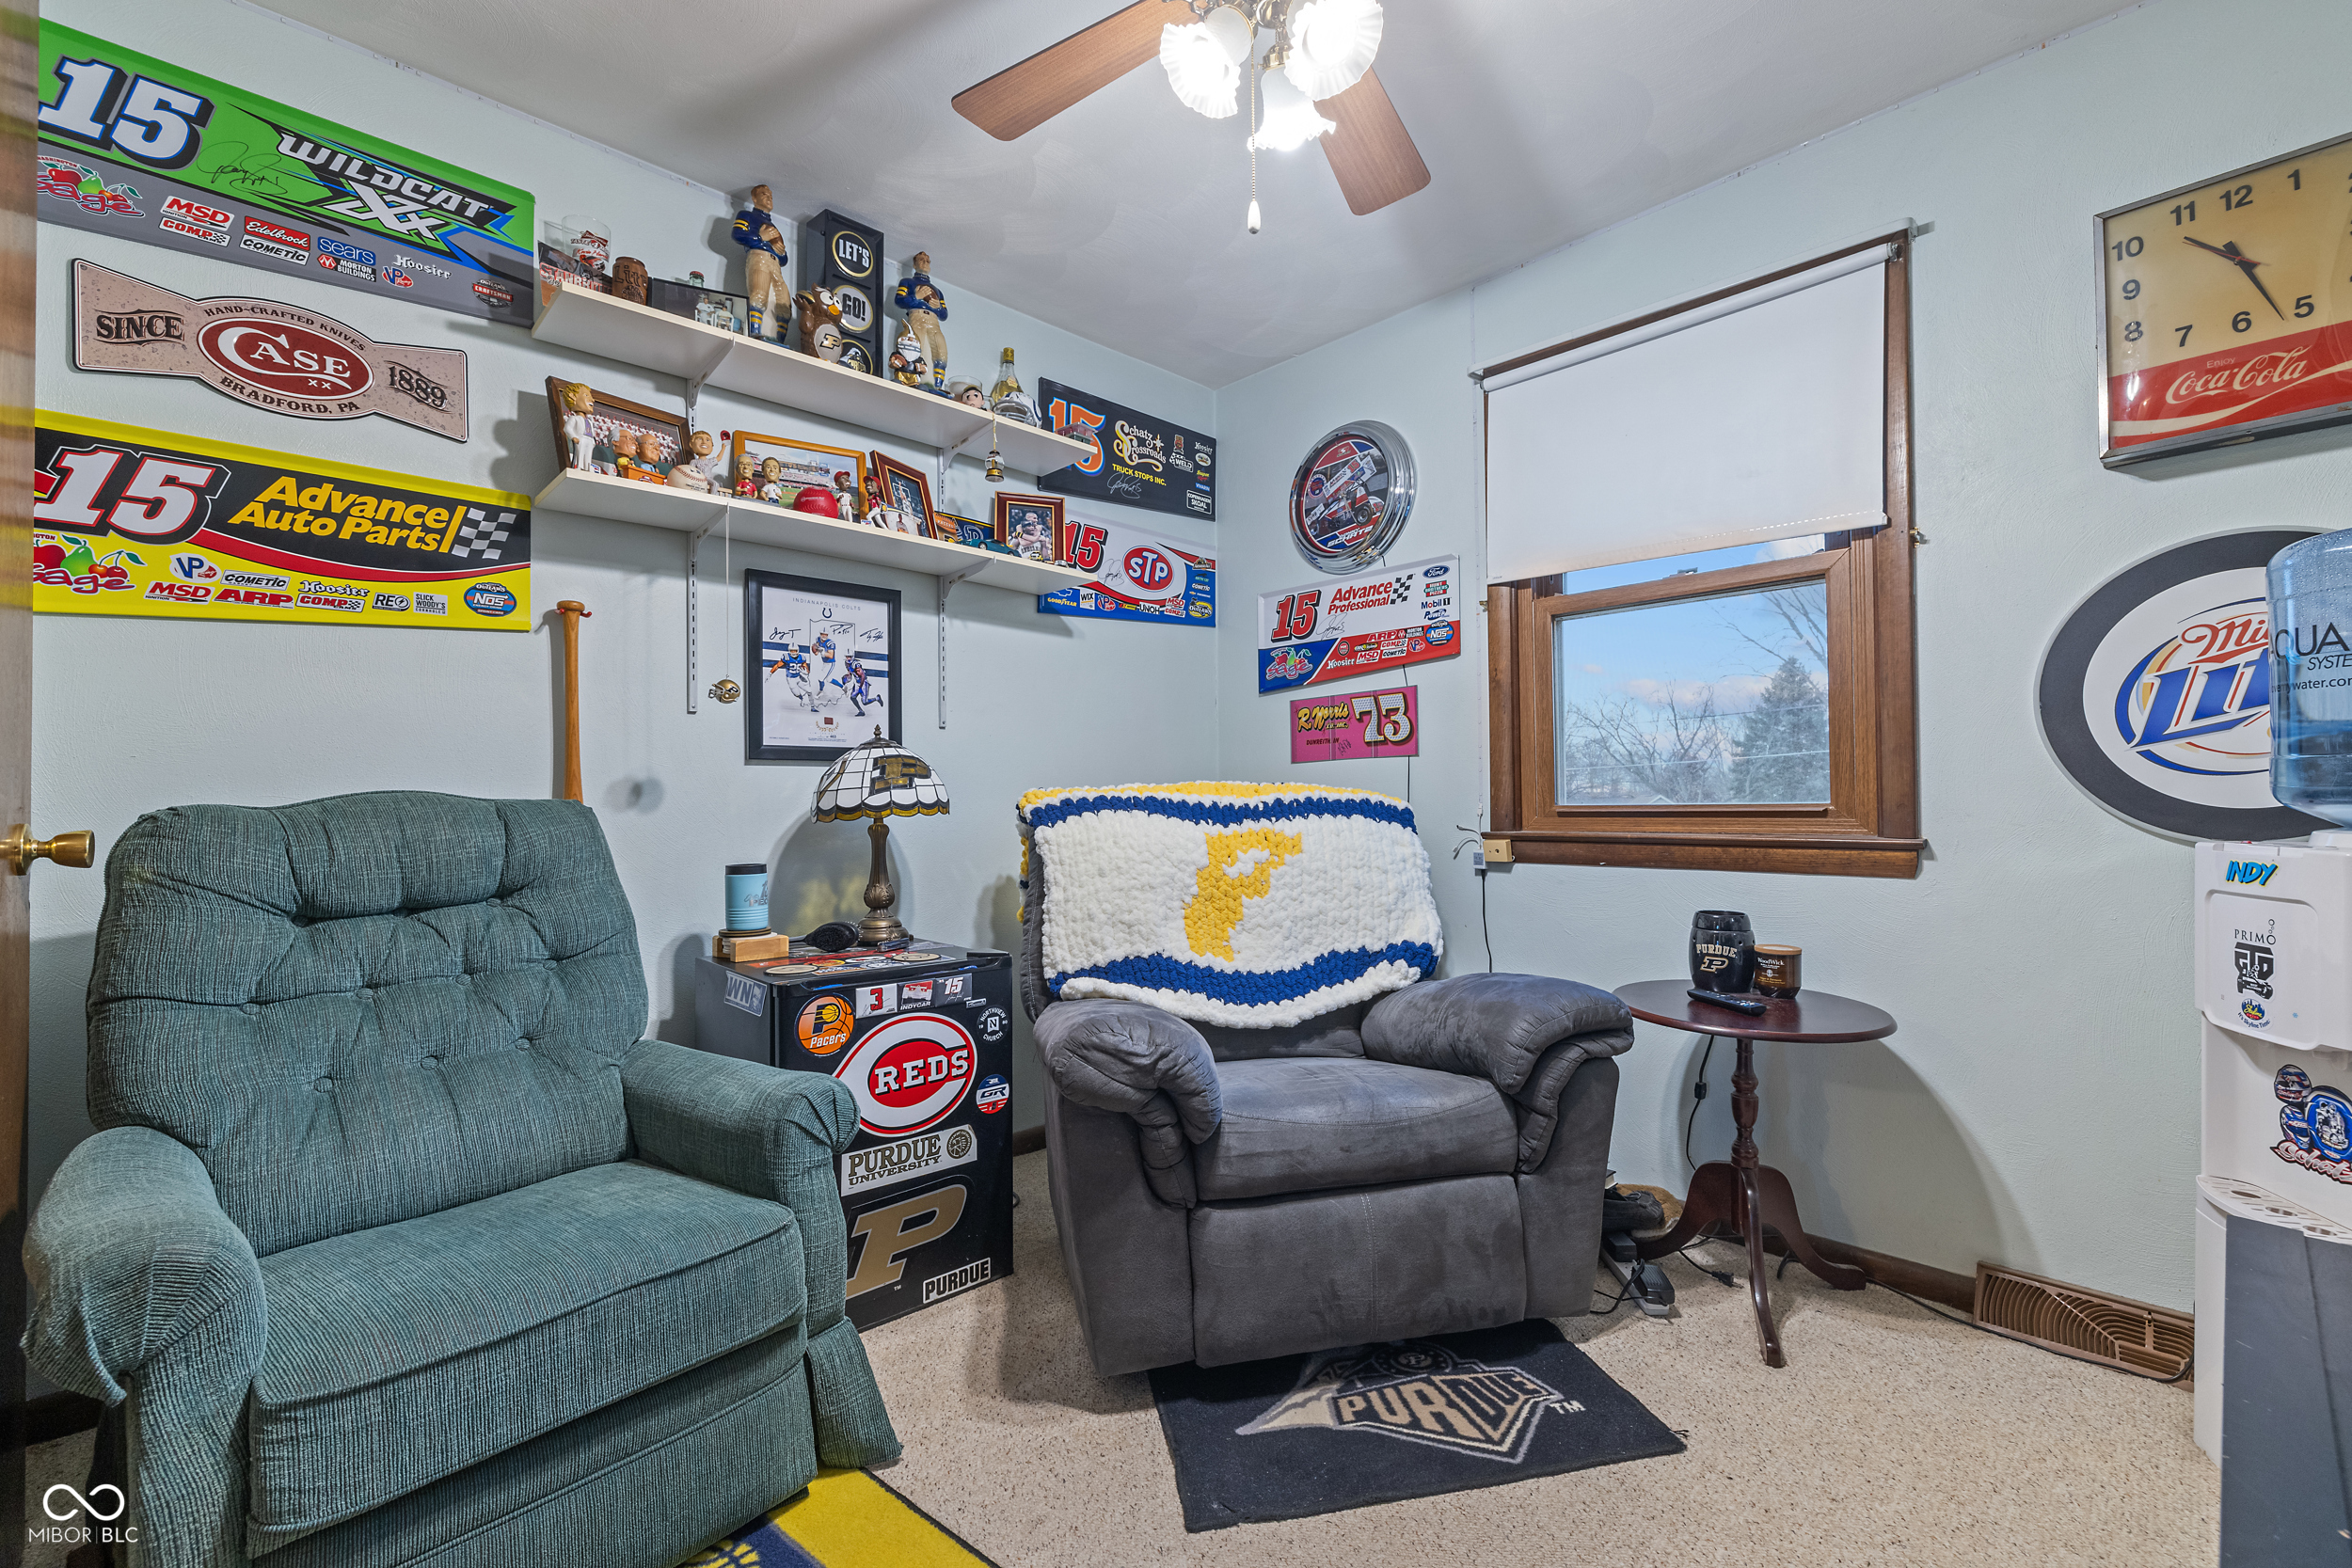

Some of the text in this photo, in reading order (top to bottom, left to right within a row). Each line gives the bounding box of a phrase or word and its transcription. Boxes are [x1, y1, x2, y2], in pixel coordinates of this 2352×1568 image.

[39, 57, 207, 161] 15
[278, 134, 489, 217] WILDCAT
[2287, 168, 2301, 191] 1
[2219, 184, 2253, 212] 12
[167, 198, 230, 225] MSD
[2169, 200, 2197, 226] 11
[163, 219, 213, 238] COMP
[246, 221, 309, 247] Edelbrock
[243, 239, 307, 261] COMETIC
[320, 239, 373, 264] sears
[838, 238, 870, 268] LET'S
[2112, 236, 2144, 261] 10
[337, 264, 375, 282] BUILDINGS
[340, 260, 373, 274] MORTON
[393, 255, 453, 279] Hoosier
[475, 285, 511, 300] CRAFTSMAN
[2122, 279, 2141, 301] 9
[842, 293, 866, 322] GO!
[2294, 294, 2315, 319] 5
[96, 314, 183, 341] SINCE
[2124, 321, 2143, 342] 8
[2232, 310, 2252, 334] 6
[319, 322, 367, 351] KNIVES
[2174, 324, 2193, 348] 7
[2166, 344, 2312, 404] Coca-Cola
[2206, 356, 2236, 370] Enjoy
[220, 376, 361, 415] BRADFORD, PA
[387, 365, 449, 410] 1889
[1114, 420, 1154, 453] Schatz
[1122, 435, 1167, 471] Crossroads
[1175, 458, 1192, 468] WELD
[1112, 463, 1133, 476] TRUCK
[1134, 470, 1154, 483] STOPS
[1154, 476, 1167, 486] INC.
[35, 448, 217, 535] 15
[254, 475, 450, 529] Advance
[1191, 499, 1207, 509] SKOAL
[228, 501, 444, 553] Auto Parts
[1065, 520, 1106, 569] 15
[1128, 550, 1169, 585] STP
[1427, 566, 1445, 577] Ford
[149, 582, 212, 598] MSD
[225, 574, 286, 588] COMETIC
[298, 580, 370, 597] Hoosier
[1331, 580, 1393, 604] Advance
[215, 589, 294, 605] ARP
[299, 595, 349, 608] COMP
[415, 600, 446, 610] WOODY'S
[473, 592, 508, 607] NOS
[793, 597, 839, 609] INDIANAPOLIS
[1047, 597, 1077, 607] GOODYEAR
[1081, 593, 1094, 602] WIX
[1167, 597, 1184, 607] MSD
[1327, 594, 1391, 615] Professional
[1422, 598, 1442, 610] Mobil
[1139, 603, 1160, 614] UNOH
[1272, 590, 1321, 641] 15
[1367, 630, 1397, 642] ARP
[1327, 657, 1355, 670] Hoosier
[1359, 651, 1379, 660] MSD
[1350, 692, 1413, 745] 73
[2226, 861, 2279, 886] INDY
[2234, 928, 2276, 945] PRIMO
[1696, 943, 1738, 958] PURDUE
[1757, 957, 1785, 966] WoodWick
[1700, 957, 1728, 973] P
[945, 976, 964, 995] 15
[870, 988, 883, 1010] 3
[900, 1001, 930, 1010] INDYCAR
[979, 1007, 1007, 1022] NORTHVIEW
[990, 1019, 997, 1029] N
[810, 1032, 847, 1049] Pacers
[982, 1031, 1004, 1042] CHURCH
[874, 1050, 969, 1096] REDS
[979, 1085, 1007, 1099] GR
[848, 1135, 942, 1177] PURDUE
[848, 1156, 942, 1186] UNIVERSITY
[847, 1183, 967, 1298] P
[925, 1262, 990, 1302] PURDUE
[1335, 1370, 1539, 1443] PURDUE
[1549, 1400, 1586, 1414] TM
